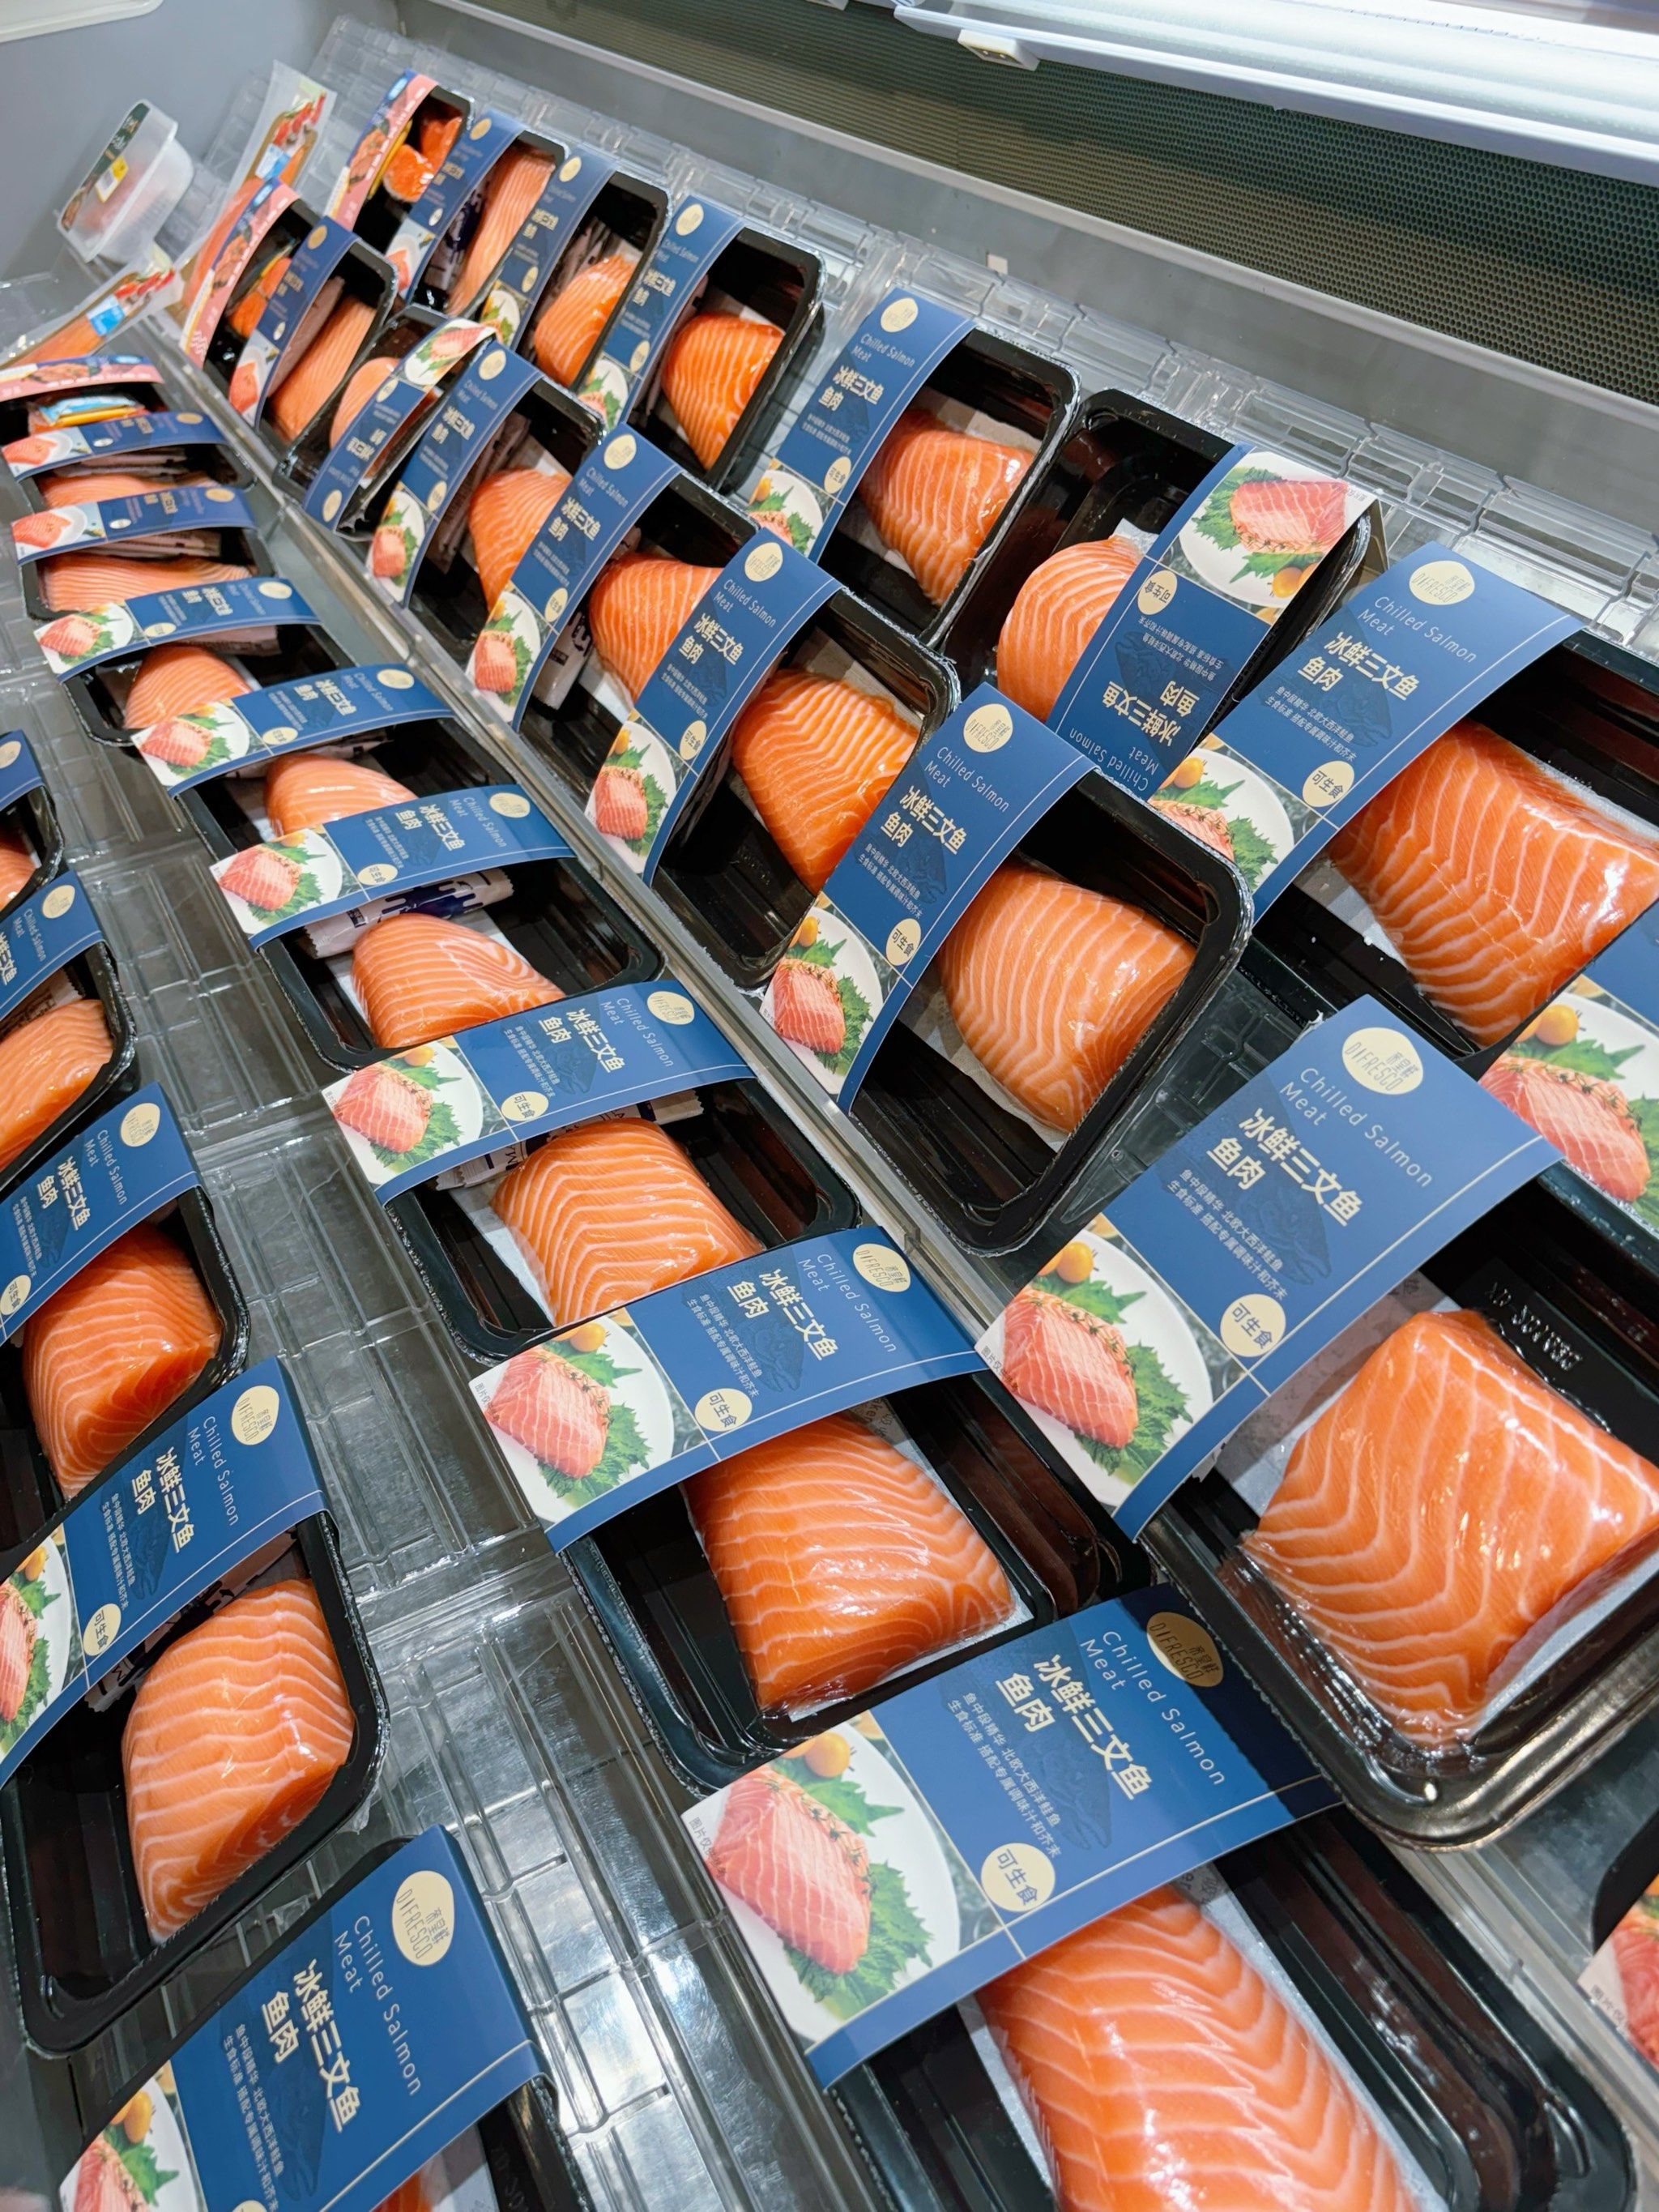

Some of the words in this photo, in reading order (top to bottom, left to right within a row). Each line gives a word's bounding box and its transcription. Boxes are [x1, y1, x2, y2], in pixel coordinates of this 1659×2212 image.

[714, 591, 733, 612] Meat
[723, 579, 752, 605] Chilled
[748, 600, 775, 627] Salmon
[1144, 580, 1171, 602] 可生食
[1411, 573, 1457, 602] DIFRESCO
[694, 613, 743, 664] 冰鲜三文鱼
[1358, 609, 1394, 635] Meat
[1375, 596, 1427, 630] Chilled
[1424, 626, 1476, 662] Salmon
[679, 635, 703, 664] 鱼肉
[1324, 632, 1418, 699] 冰鲜三文鱼
[1298, 656, 1342, 690] 鱼肉
[1102, 681, 1180, 745] 冰鲜三文鱼
[1160, 681, 1199, 716] 鱼肉
[684, 729, 700, 751] 可生食
[965, 719, 999, 749] DIFRESCO
[1069, 728, 1107, 762] Salmon
[924, 760, 950, 787] Meat
[937, 746, 975, 780] Chilled
[971, 775, 1009, 812] Salmon
[1107, 756, 1149, 791] Chilled
[1128, 746, 1159, 775] Meat
[1312, 770, 1342, 798] 可生食
[881, 812, 912, 847] 鱼肉
[900, 786, 966, 853] 冰鲜三文鱼
[892, 928, 914, 957] 可生食
[538, 1017, 571, 1043] 鱼肉
[600, 1001, 624, 1024] Meat
[616, 998, 647, 1030] Chilled
[642, 1032, 672, 1065] Salmon
[566, 1009, 624, 1072] 冰鲜三文鱼
[1345, 1042, 1402, 1091] DIFRESCO
[514, 1094, 535, 1118] 可生食
[1280, 1082, 1326, 1125] Meat
[1300, 1068, 1367, 1125] Chilled
[1364, 1125, 1431, 1185] Salmon
[84, 1138, 99, 1167] Meat
[97, 1129, 117, 1166] Chilled
[109, 1165, 126, 1204] Salmon
[1207, 1138, 1265, 1189] 鱼肉
[1240, 1109, 1360, 1224] 冰鲜三文鱼
[36, 1175, 58, 1208] 鱼肉
[58, 1156, 90, 1229] 冰鲜三文鱼
[798, 1258, 830, 1291] Meat
[855, 1249, 893, 1286] DIFRESCO
[8, 1280, 20, 1309] 可生食
[727, 1281, 768, 1317] 鱼肉
[759, 1269, 837, 1359] 冰鲜三文鱼
[817, 1254, 860, 1299] Chilled
[855, 1303, 898, 1352] Salmon
[1232, 1303, 1272, 1348] 可生食
[236, 1397, 258, 1441] DIFRESCO
[710, 1392, 736, 1427] 可生食
[188, 1426, 205, 1465] Meat
[131, 1470, 156, 1514] 鱼肉
[203, 1416, 226, 1468] Chilled
[217, 1470, 238, 1525] Salmon
[156, 1447, 194, 1552] 冰鲜三文鱼
[94, 1609, 108, 1650] 可生食
[1149, 1622, 1204, 1680] DIFRESCO
[1080, 1639, 1124, 1689] Meat
[996, 1673, 1054, 1731] 鱼肉
[1103, 1631, 1166, 1700] Chilled
[1161, 1707, 1224, 1783] Salmon
[1034, 1655, 1150, 1798] 冰鲜三文鱼
[997, 1849, 1037, 1905] 可生食
[396, 1889, 432, 1958] DIFRESCO
[335, 1930, 361, 1992] Meat
[262, 1992, 298, 2062] 鱼肉
[354, 1915, 392, 2000] Chilled
[383, 2003, 420, 2095] Salmon
[294, 1960, 359, 2130] 冰鲜三文鱼
